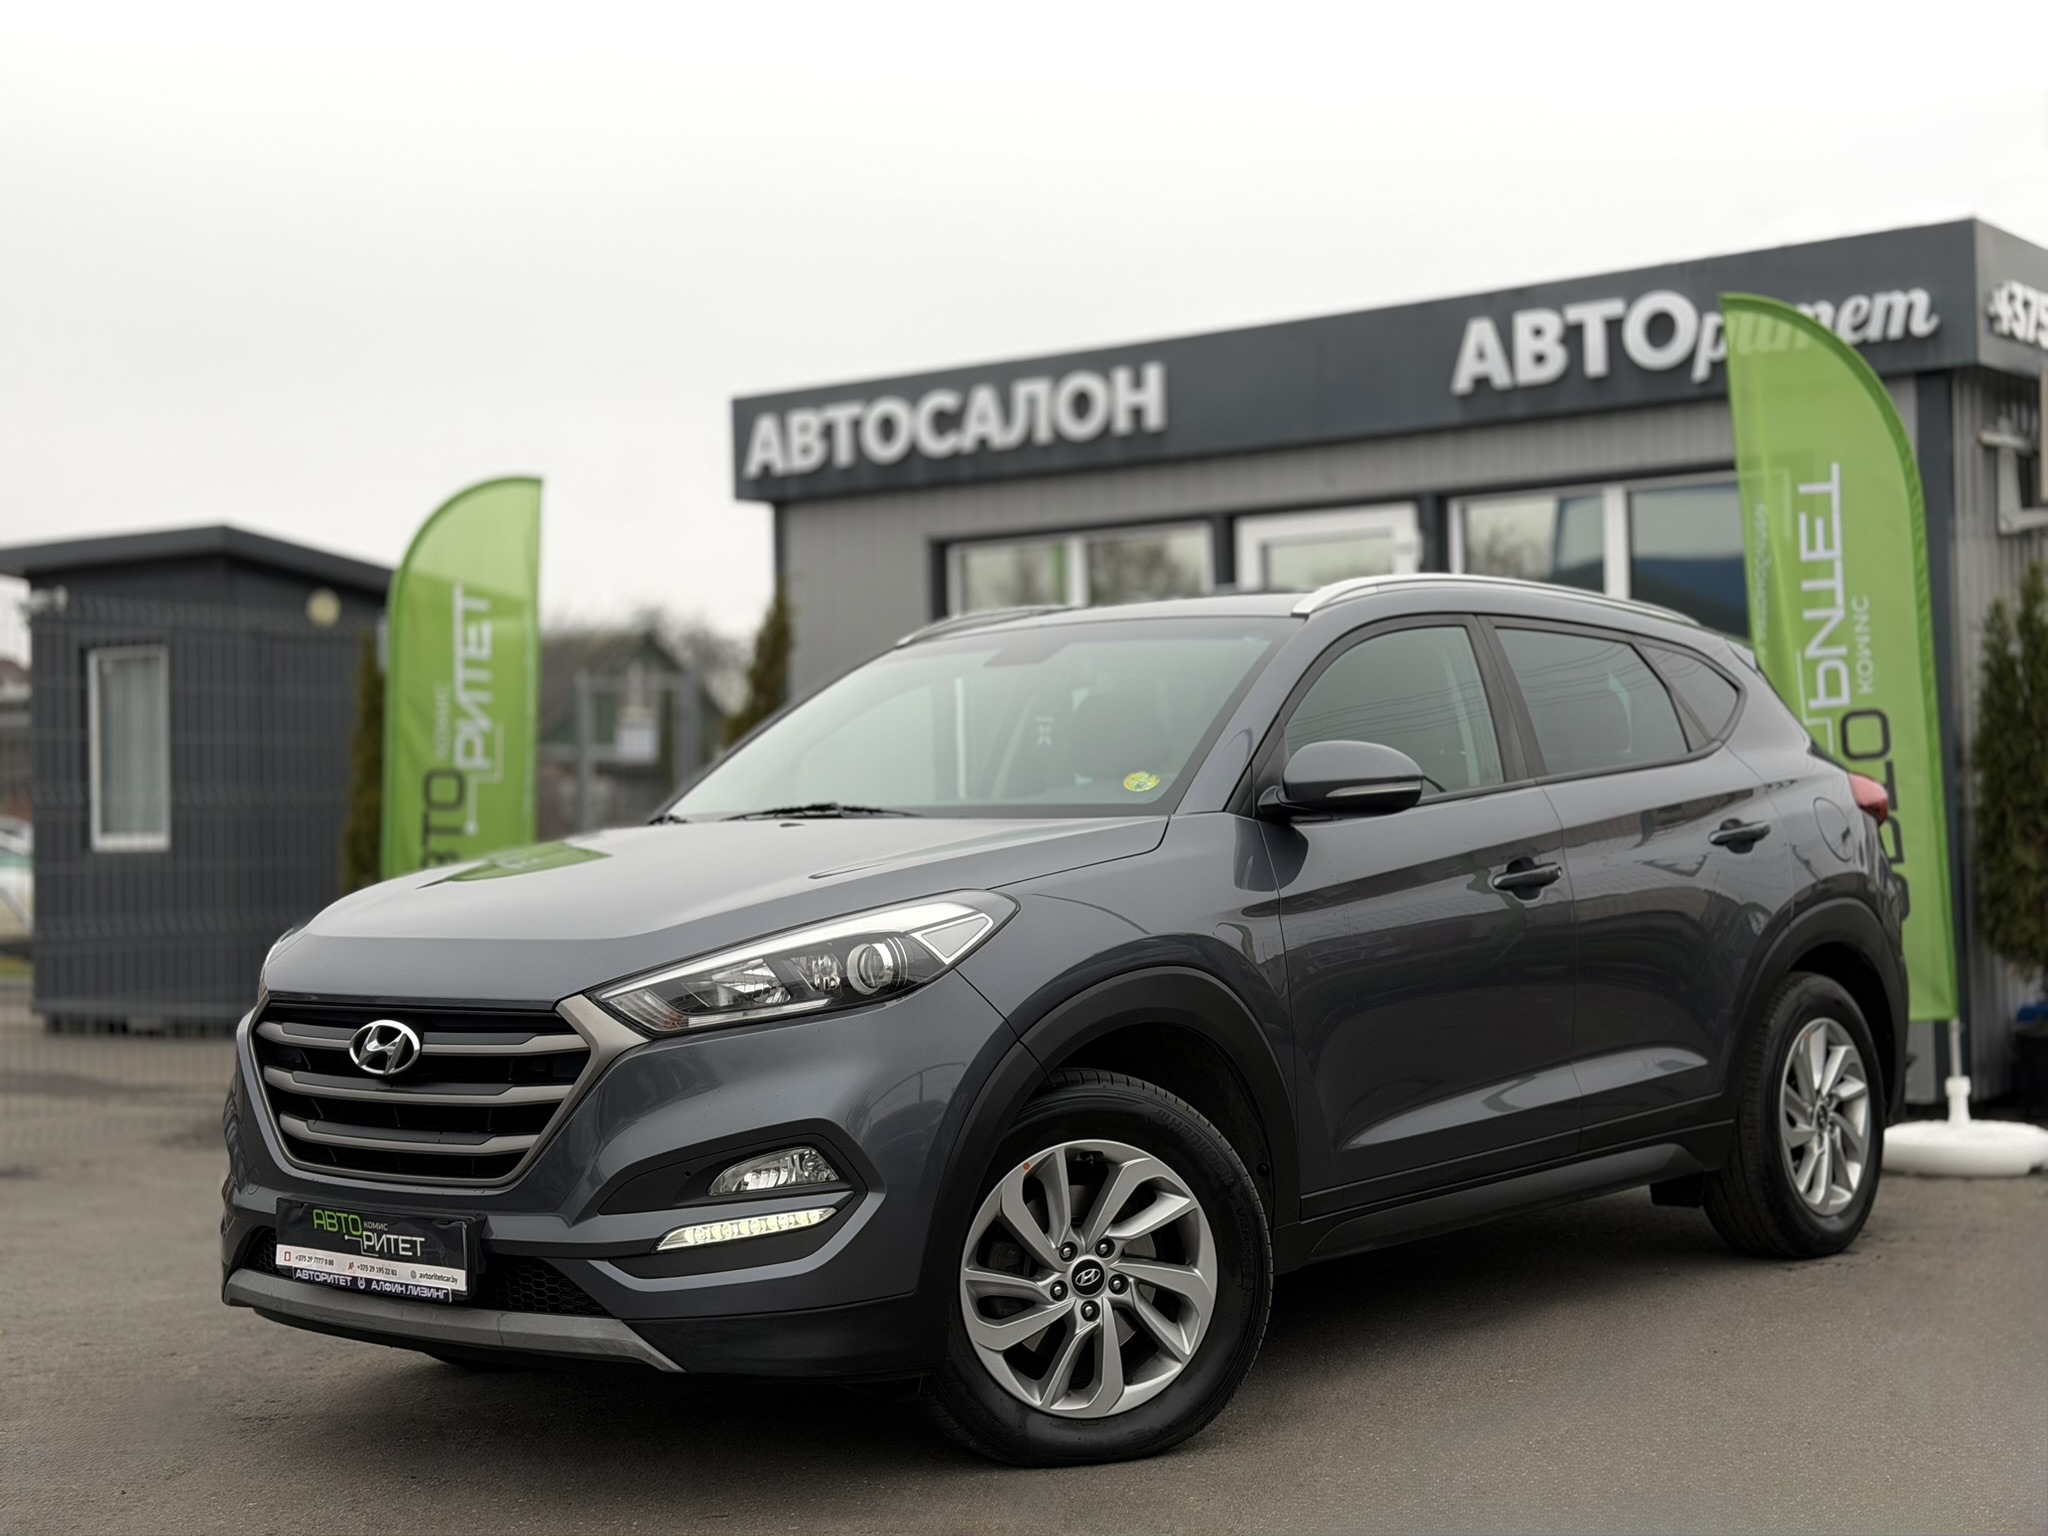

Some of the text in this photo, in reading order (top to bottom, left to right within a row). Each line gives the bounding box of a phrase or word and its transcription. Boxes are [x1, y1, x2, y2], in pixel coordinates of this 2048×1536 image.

[743, 363, 1166, 480] АВТОСАЛОН
[454, 583, 492, 770] РИТЕТ
[312, 1208, 363, 1236] АВТО
[363, 1220, 389, 1231] КОМИС
[362, 1231, 425, 1257] РИТЕТ
[295, 1268, 448, 1300] АВТОРИТЕТ АЛФИН ЛИЗИНГ
[418, 1271, 459, 1285] avtoritetcar.by
